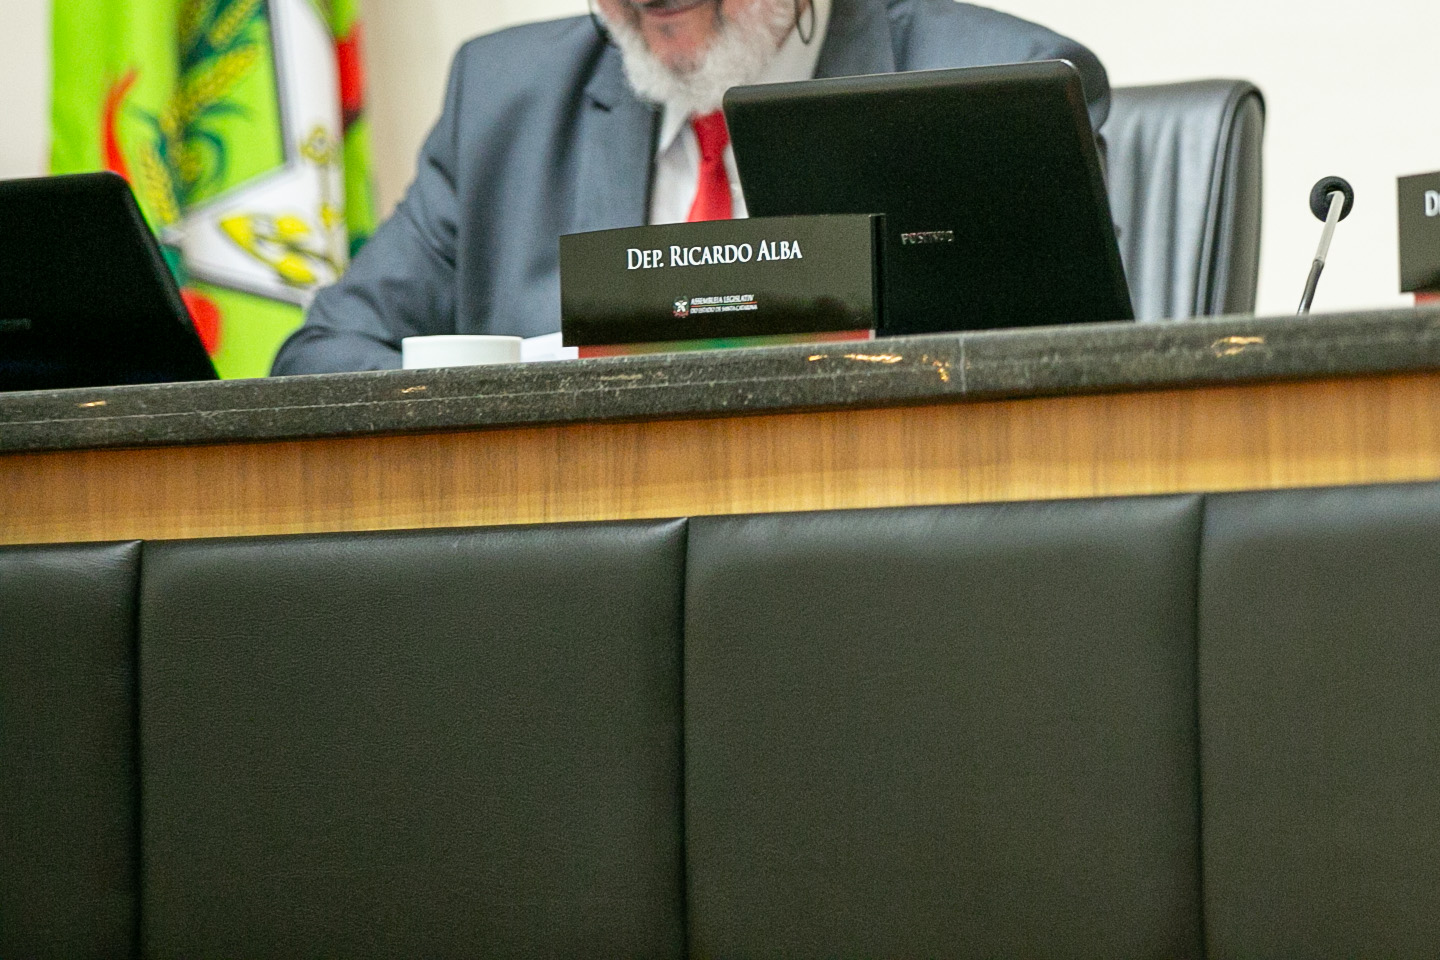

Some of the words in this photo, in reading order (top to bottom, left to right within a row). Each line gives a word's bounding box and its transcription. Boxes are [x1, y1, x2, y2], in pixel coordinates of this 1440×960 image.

[626, 247, 665, 270] DEP.
[669, 243, 753, 267] RICARDO
[756, 239, 803, 261] ALBA
